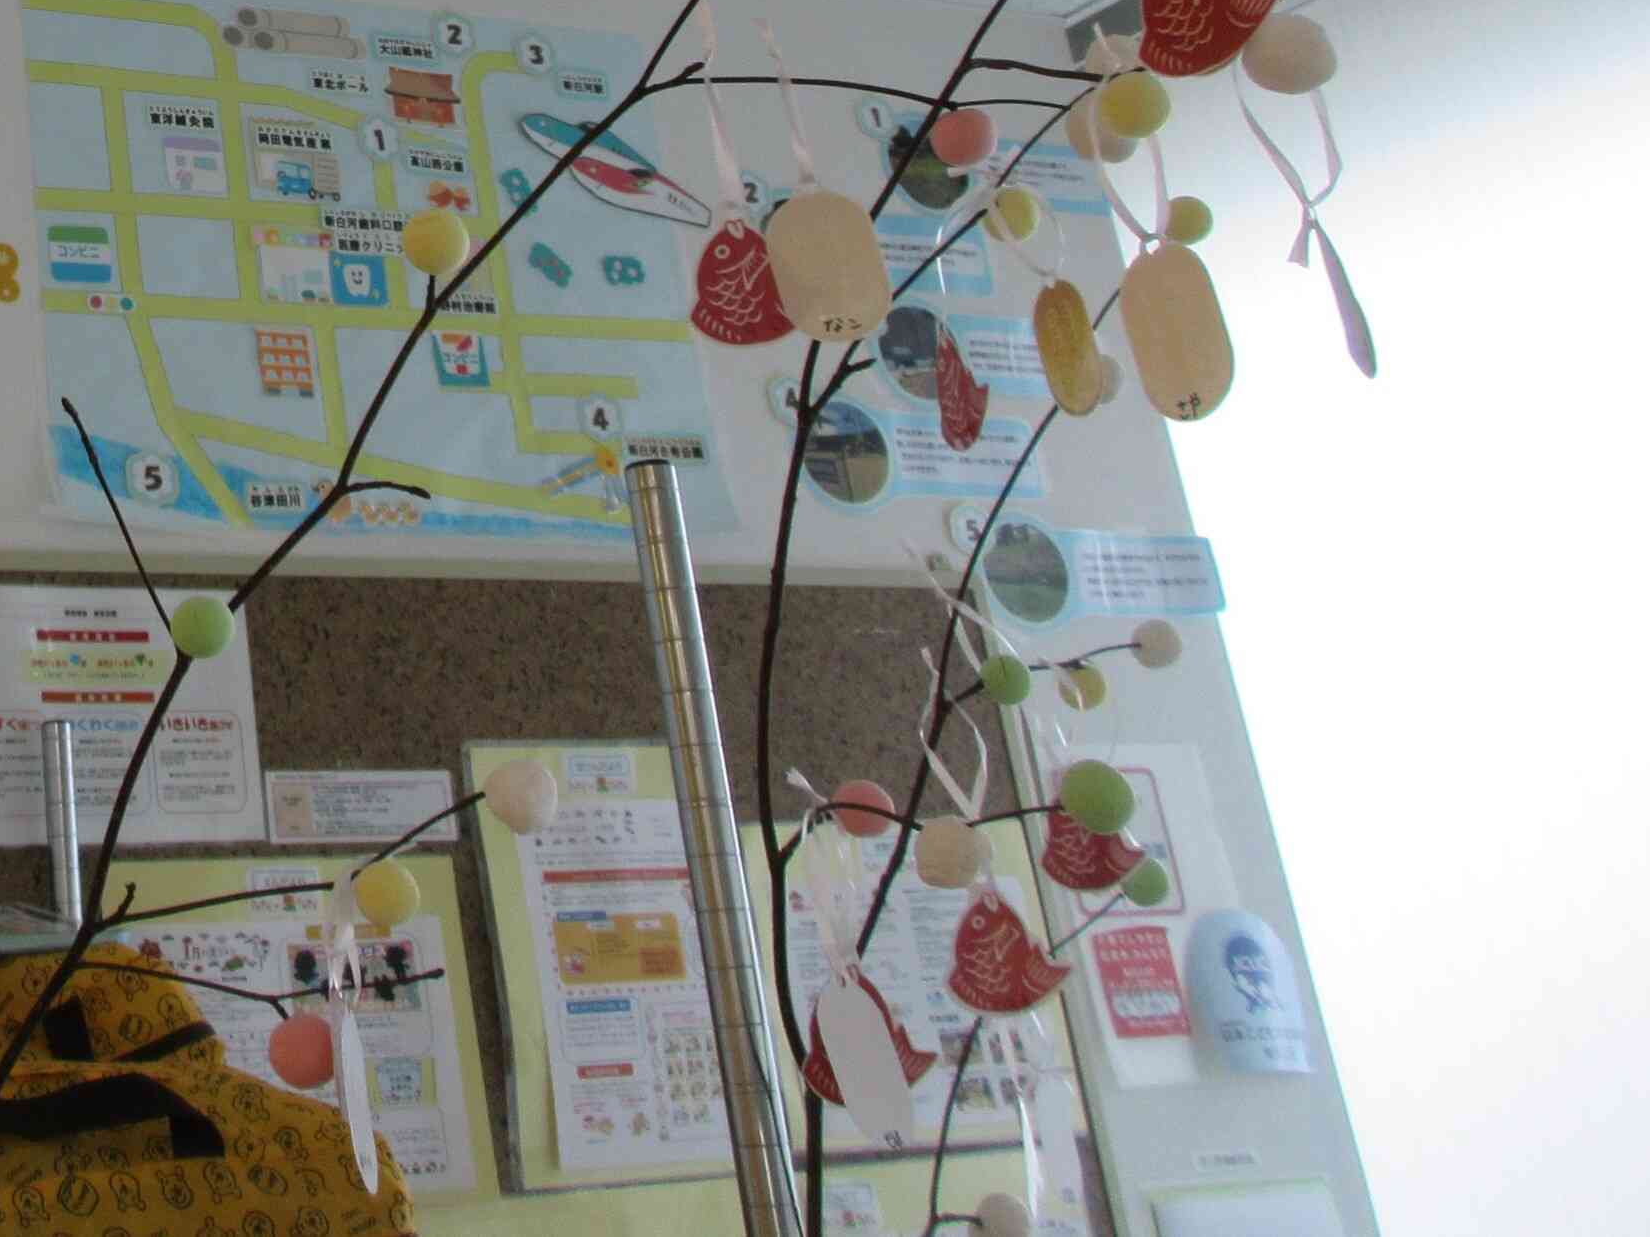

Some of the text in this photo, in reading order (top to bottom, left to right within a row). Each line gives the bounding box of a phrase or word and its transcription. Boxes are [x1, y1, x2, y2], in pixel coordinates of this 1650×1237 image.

[446, 24, 463, 45] 2
[529, 44, 544, 65] 3
[871, 107, 881, 128] 1
[374, 129, 385, 151] 1
[743, 182, 759, 203] 2
[592, 407, 609, 430] 4
[144, 465, 163, 491] 5
[966, 519, 984, 542] 5
